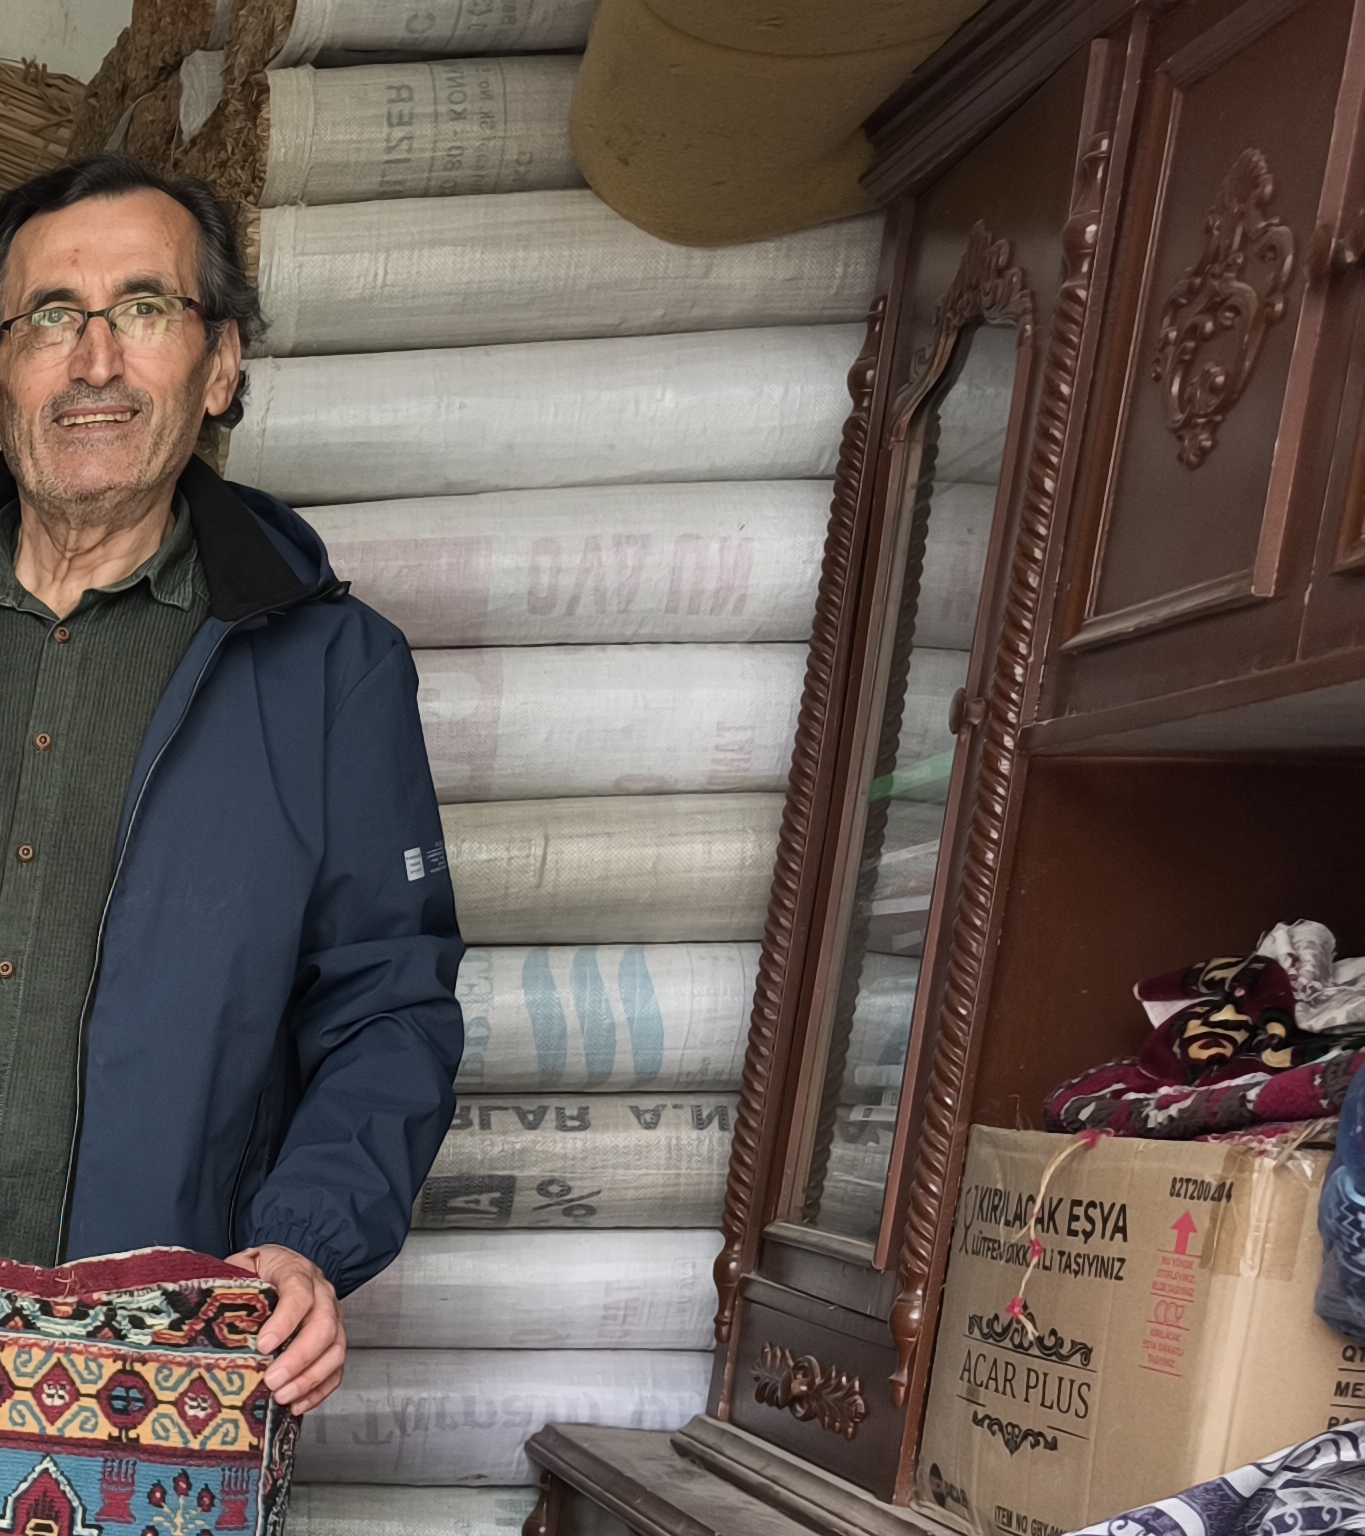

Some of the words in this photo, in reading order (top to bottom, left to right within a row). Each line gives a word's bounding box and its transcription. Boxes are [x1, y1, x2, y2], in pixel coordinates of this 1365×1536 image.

[976, 1186, 1065, 1236] KIRILACAK
[1066, 1198, 1129, 1245] EŞYA
[1057, 1249, 1127, 1281] TAŞIYINIZ
[958, 1348, 1017, 1400] ACAR
[1023, 1366, 1092, 1420] PLUS
[994, 1505, 1013, 1528] ITEM
[1015, 1512, 1028, 1535] NO
